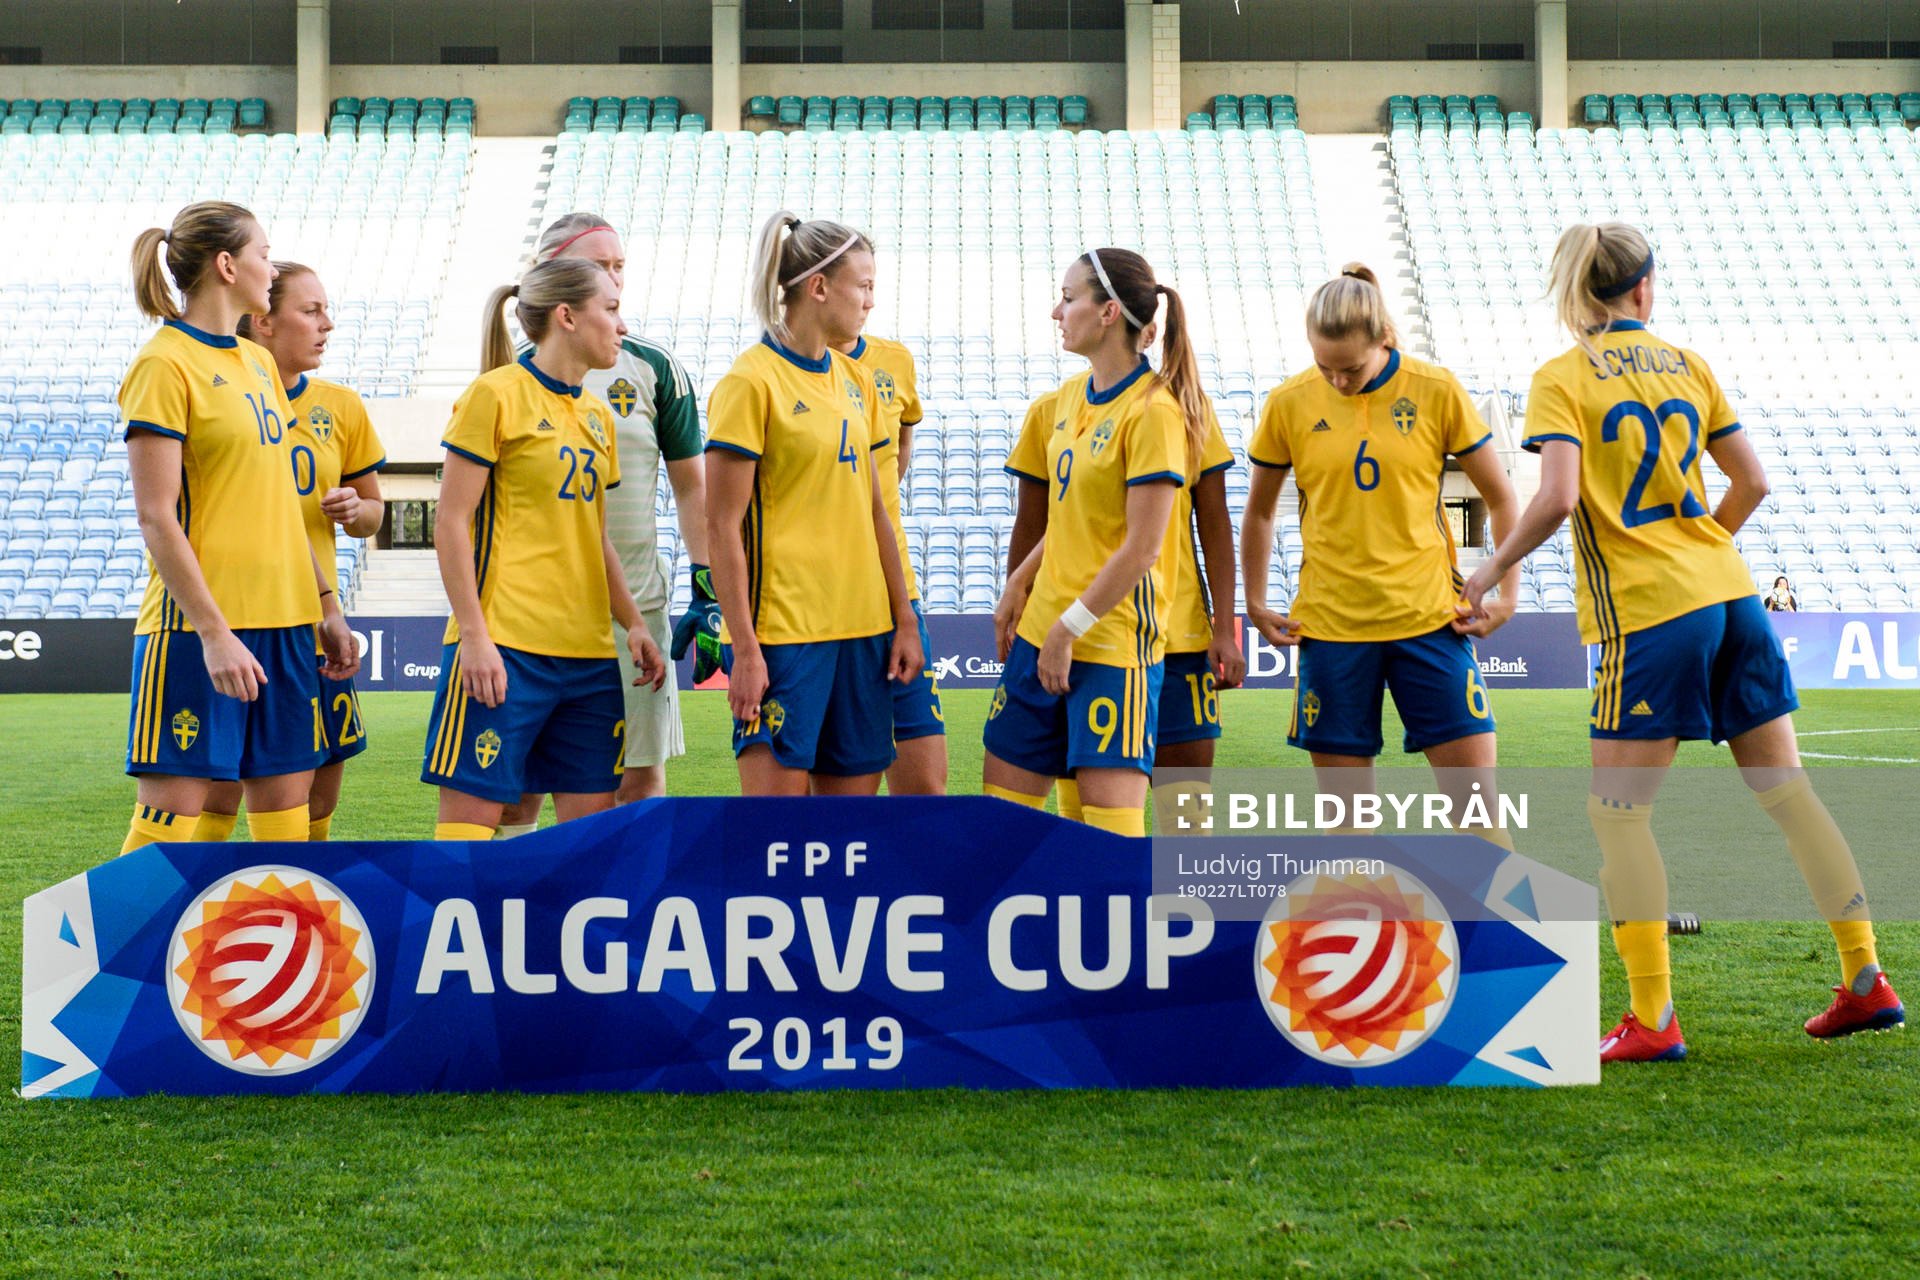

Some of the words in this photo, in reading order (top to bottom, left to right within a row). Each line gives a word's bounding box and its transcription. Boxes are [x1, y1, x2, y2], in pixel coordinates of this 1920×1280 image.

[245, 392, 283, 446] 16
[838, 418, 858, 473] 4
[558, 445, 598, 502] 23
[1056, 448, 1074, 502] 9
[1353, 439, 1381, 492] 6
[1601, 398, 1707, 529] 22
[1185, 672, 1219, 725] 18
[1466, 668, 1489, 720] 6
[1088, 696, 1118, 754] 9
[415, 894, 945, 995] ALGARVE
[987, 894, 1216, 991] CUP
[728, 1016, 904, 1071] 2019
